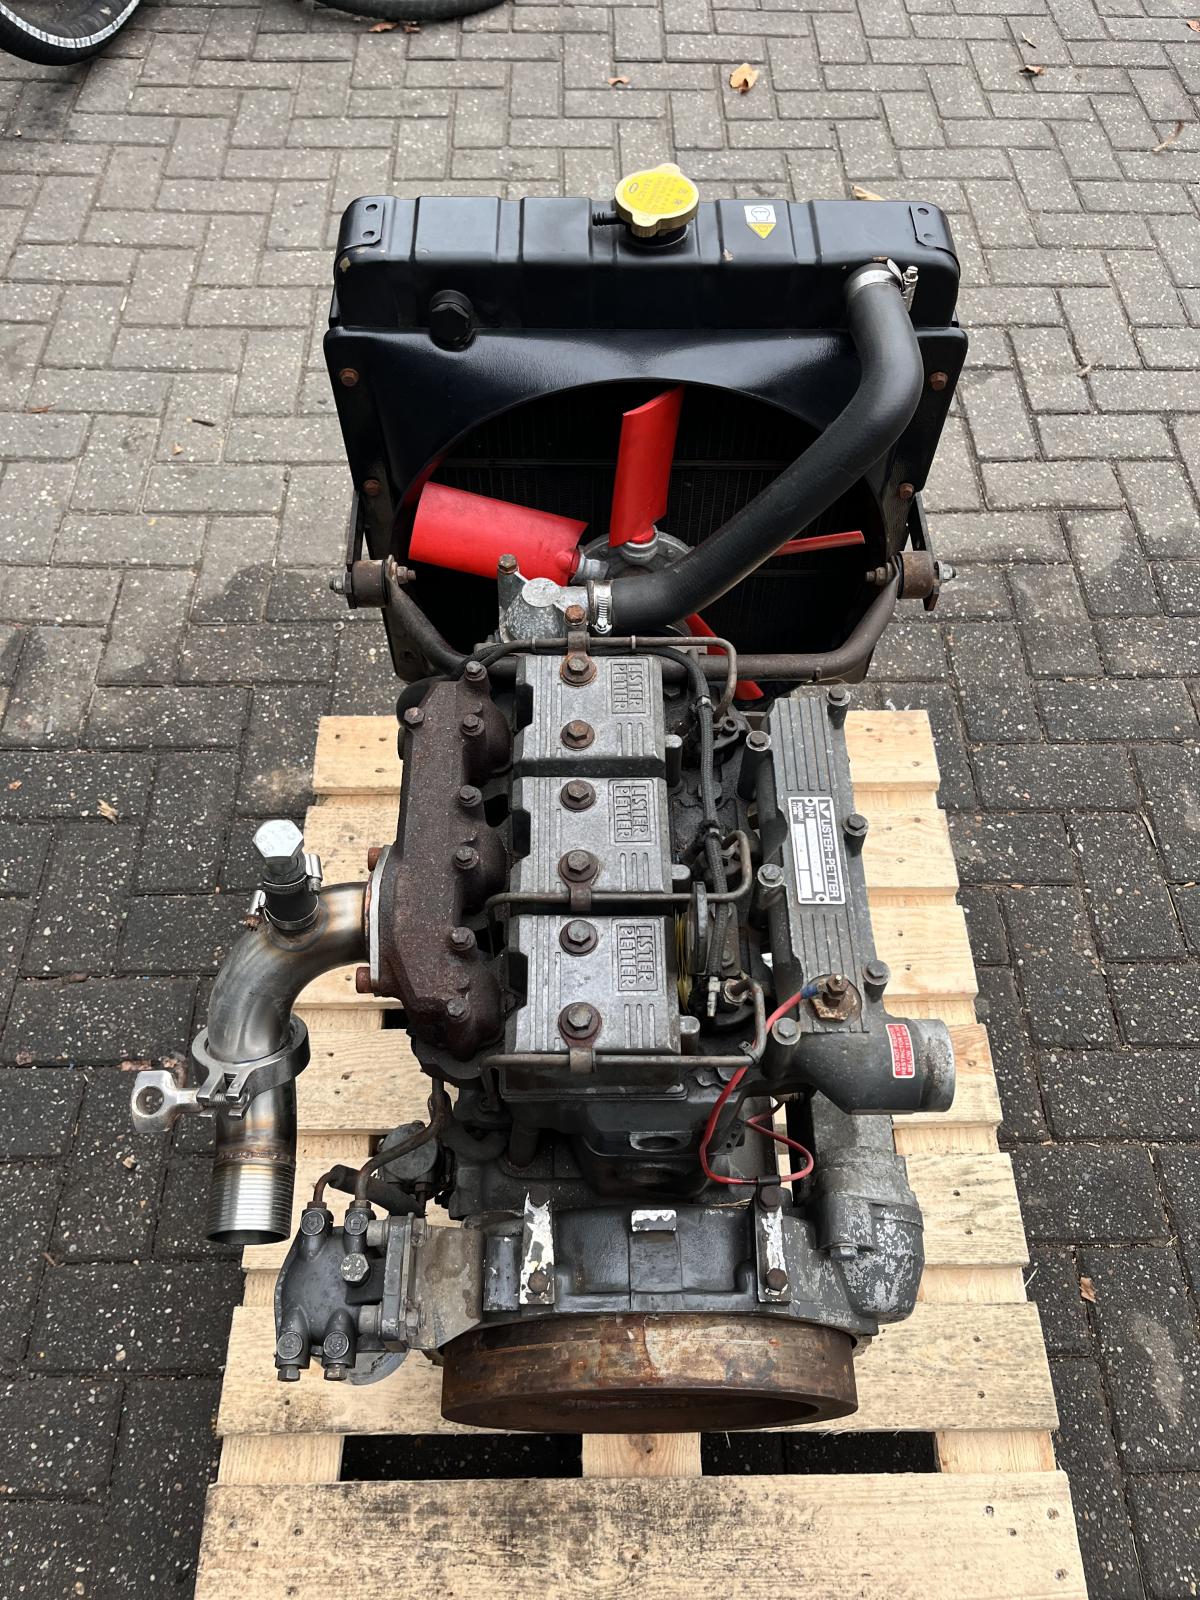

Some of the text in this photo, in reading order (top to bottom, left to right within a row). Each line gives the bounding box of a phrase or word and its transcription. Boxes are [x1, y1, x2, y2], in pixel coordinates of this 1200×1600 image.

[613, 663, 628, 709] PETTER
[628, 663, 643, 706] LISTER
[615, 786, 632, 839] PETTER
[632, 786, 648, 834] LISTER
[820, 819, 839, 898] LISTER-PETTER
[619, 926, 638, 987] PETTER
[636, 926, 656, 984] LISTER
[895, 1062, 901, 1072] DO
[898, 1037, 907, 1075] RESTRICTOR
